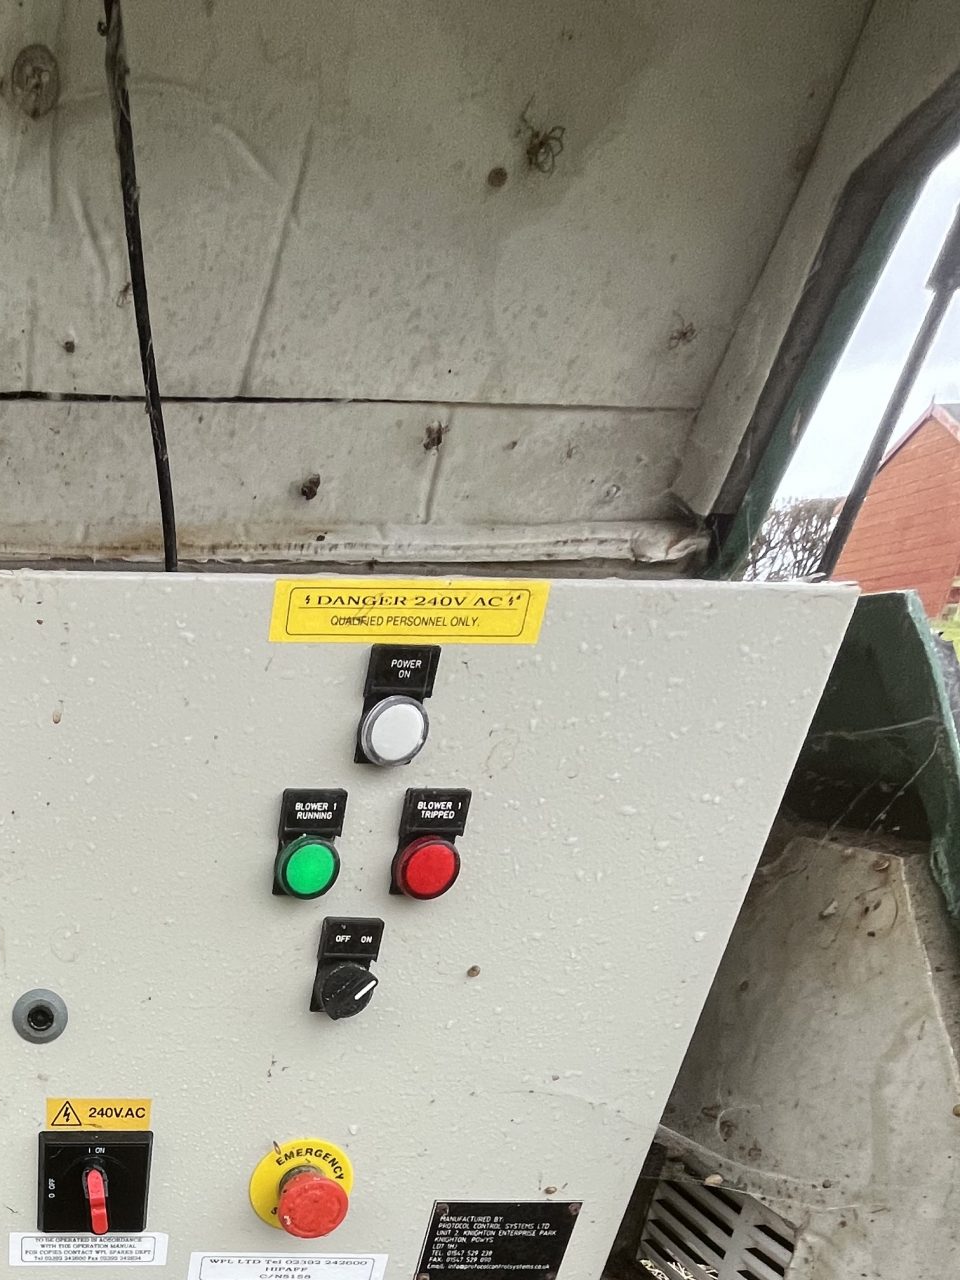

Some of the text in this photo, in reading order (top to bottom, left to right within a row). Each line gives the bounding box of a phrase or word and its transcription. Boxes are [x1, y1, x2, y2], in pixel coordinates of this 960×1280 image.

[317, 595, 504, 607] DANGER 240V AC
[330, 615, 480, 627] QUALIFIED PERSONNEL ONLY.
[390, 659, 422, 669] POWER
[398, 670, 411, 679] ON
[294, 802, 338, 811] BLOWER 1
[417, 801, 462, 810] BLOWER 1
[296, 811, 333, 820] RUNNING
[420, 810, 455, 819] TRIPPED
[335, 935, 373, 943] OFF ON
[88, 1107, 146, 1119] 240V.AC
[275, 1147, 345, 1180] EMERGENCY
[48, 1178, 56, 1190] OFF
